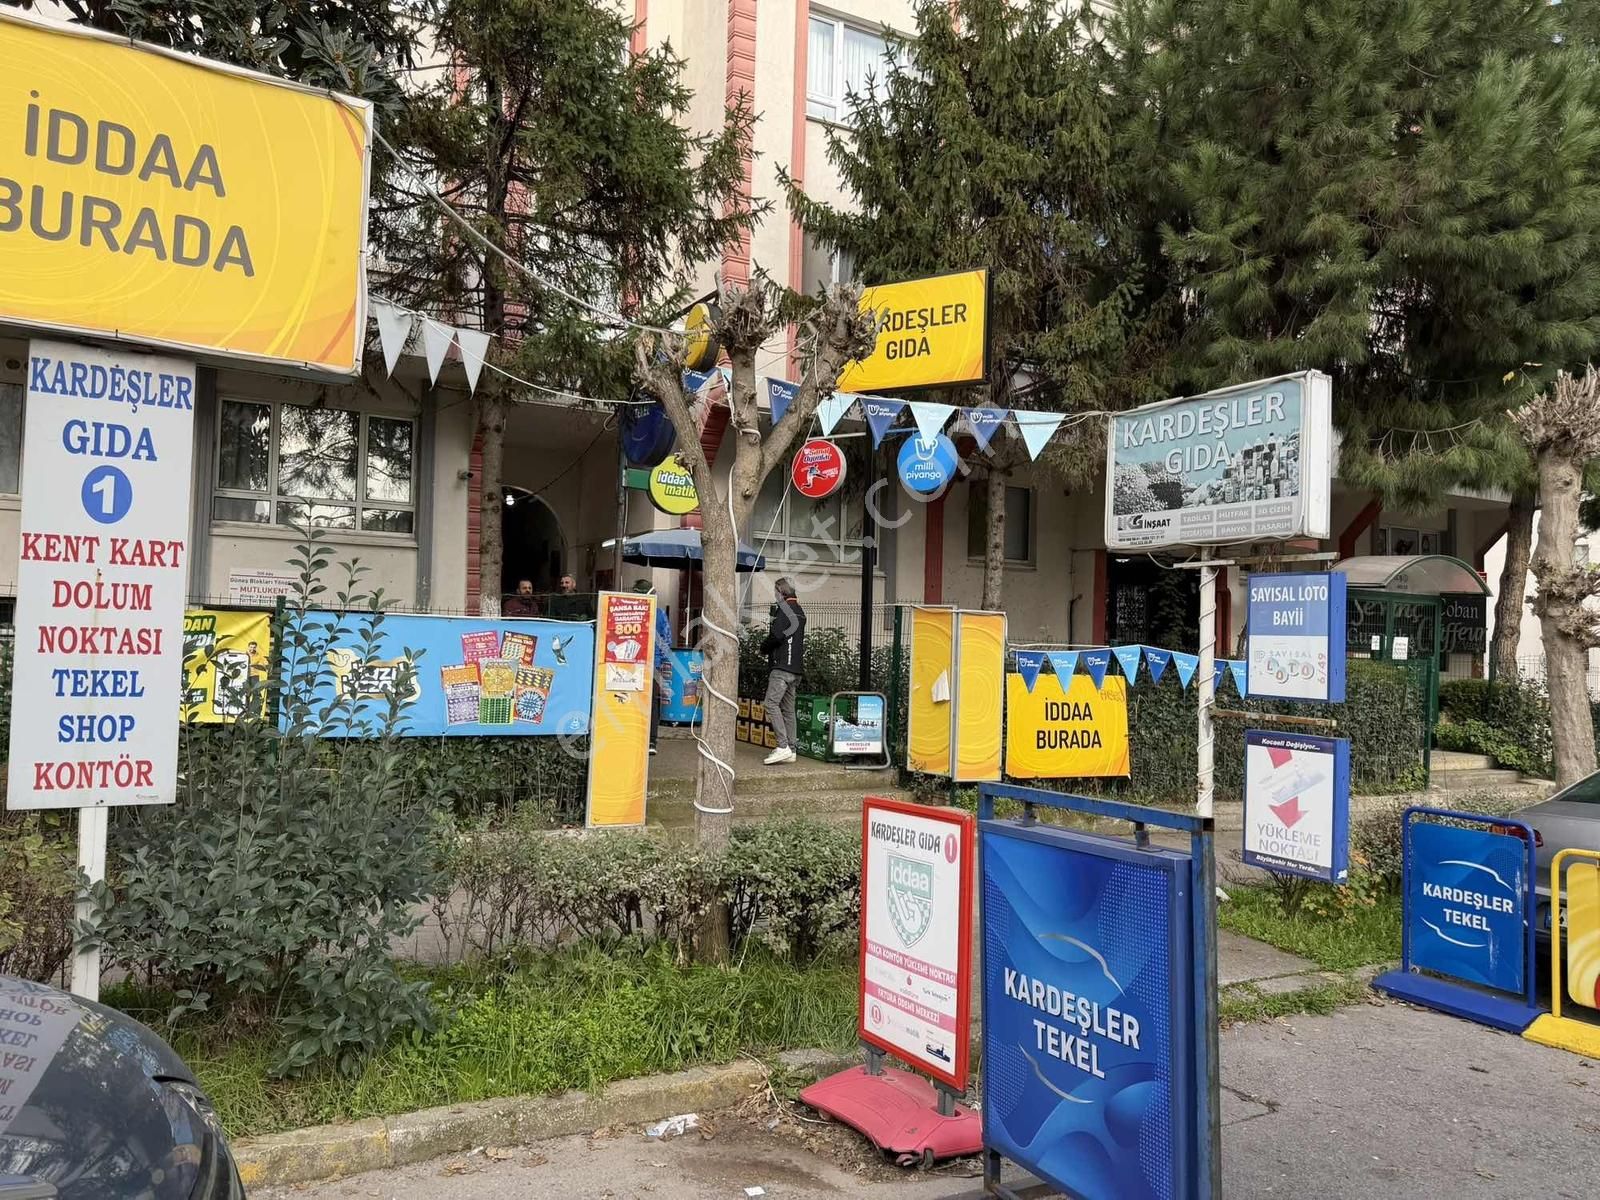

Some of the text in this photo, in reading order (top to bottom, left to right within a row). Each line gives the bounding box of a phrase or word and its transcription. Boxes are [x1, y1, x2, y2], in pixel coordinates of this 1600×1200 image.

[25, 90, 226, 198] İDDAA
[0, 176, 255, 278] BURADA
[879, 303, 968, 333] RDEŞLER
[886, 337, 931, 360] GIDA
[29, 356, 193, 413] KARDEŞLER
[1122, 391, 1286, 449] KARDEŞLER
[63, 419, 157, 462] GIDA
[1165, 440, 1233, 475] GIDA
[657, 470, 688, 486] iddaa
[905, 471, 942, 480] piyango
[91, 474, 117, 515] 1
[664, 483, 696, 499] matik
[1144, 518, 1171, 530] İNŞAAT
[21, 532, 184, 568] KENT KART
[52, 579, 152, 611] DOLUM
[240, 586, 288, 595] MUTLUKENT
[1251, 584, 1328, 602] SAYISAL LOTO
[38, 625, 162, 656] NOKTASI
[615, 623, 642, 635] 800
[52, 668, 145, 698] TEKEL
[1045, 698, 1093, 721] İDDAA
[58, 714, 136, 743] SHOP
[1036, 729, 1102, 750] BURADA
[1261, 738, 1285, 747] Kocaeli
[33, 753, 154, 791] KONTÖR
[871, 820, 917, 849] KARDEŞLER
[1257, 822, 1322, 847] YÜKLEME
[1259, 838, 1319, 862] NOKTASI
[890, 859, 931, 890] iddaa
[1422, 882, 1514, 914] KARDEŞLER
[1443, 908, 1492, 932] TEKEL
[929, 966, 956, 985] NOKTASI
[1004, 966, 1140, 1050] KARDEŞLER
[1033, 1018, 1106, 1079] TEKEL
